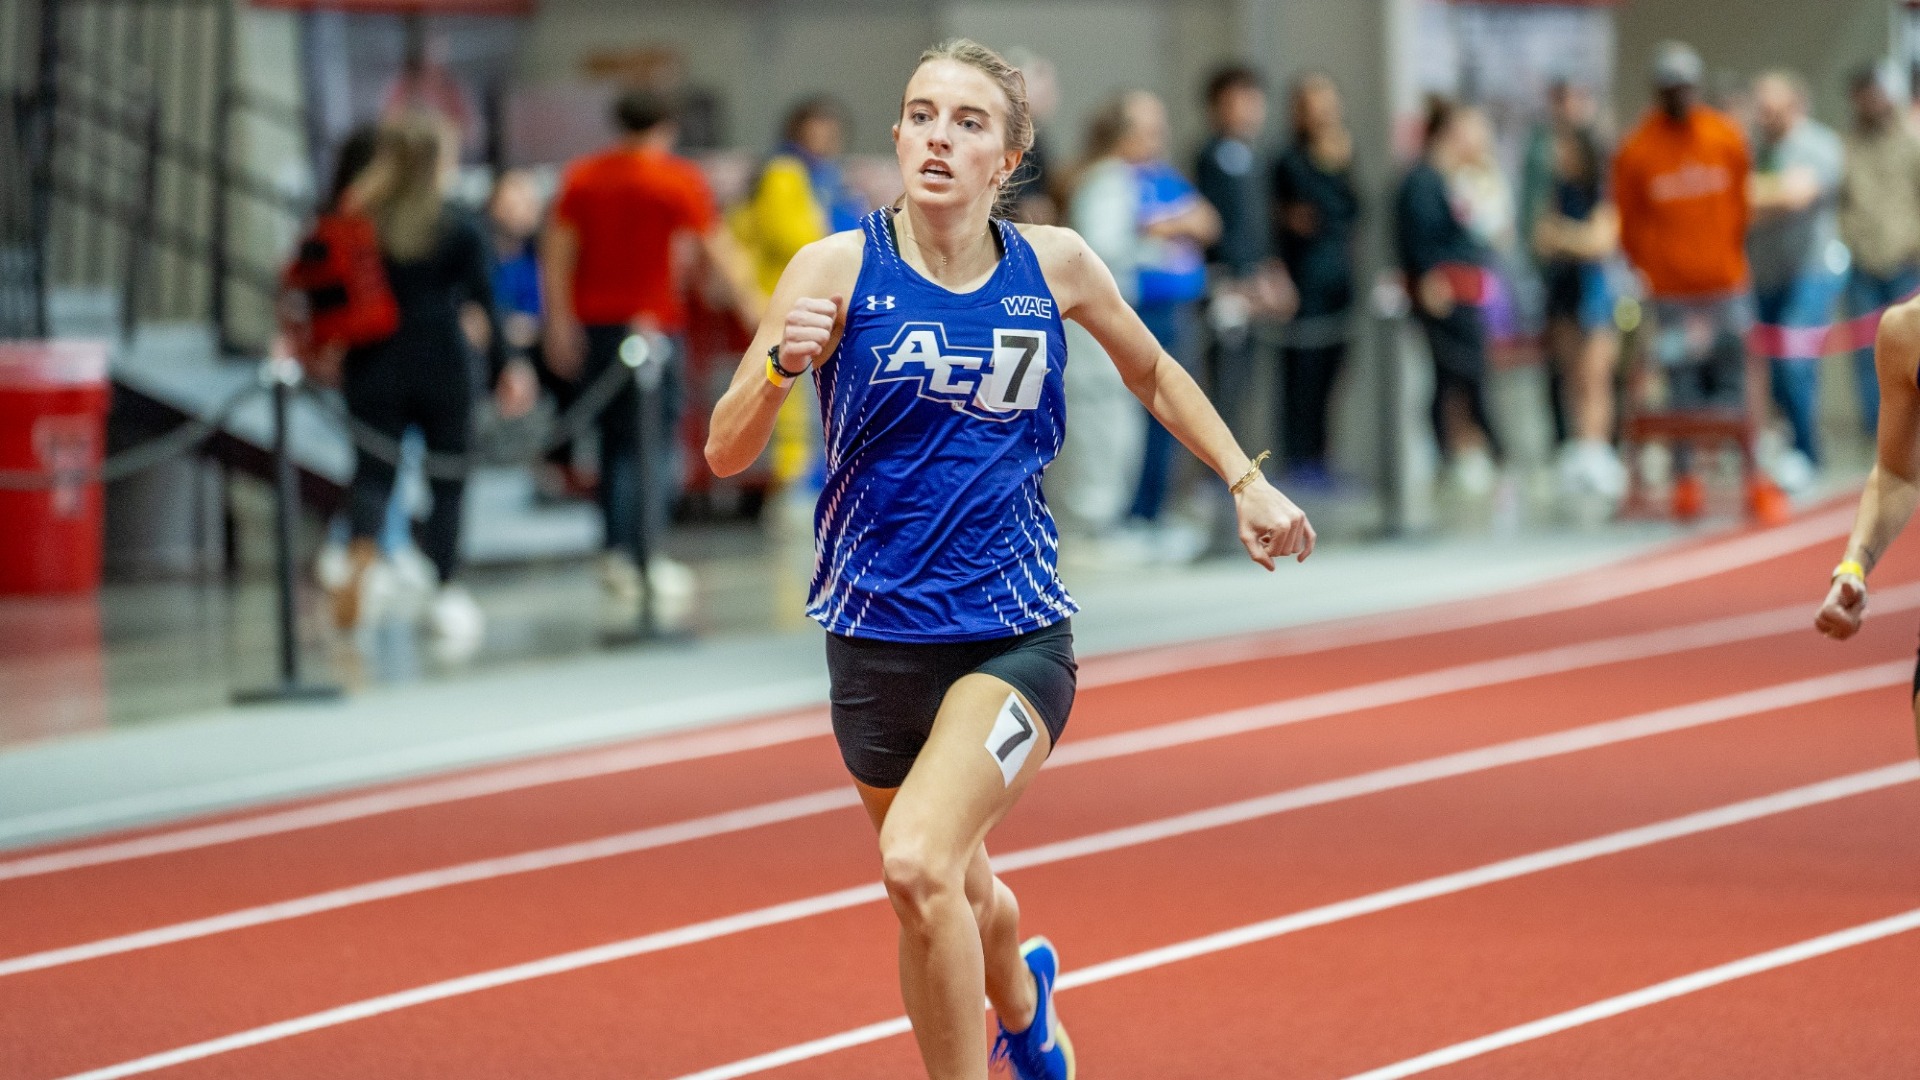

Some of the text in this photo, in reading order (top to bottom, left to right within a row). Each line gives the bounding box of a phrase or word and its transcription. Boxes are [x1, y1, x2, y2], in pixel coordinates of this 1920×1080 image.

[1001, 295, 1052, 319] WAC
[1000, 335, 1040, 403] 7
[996, 702, 1033, 763] 7
